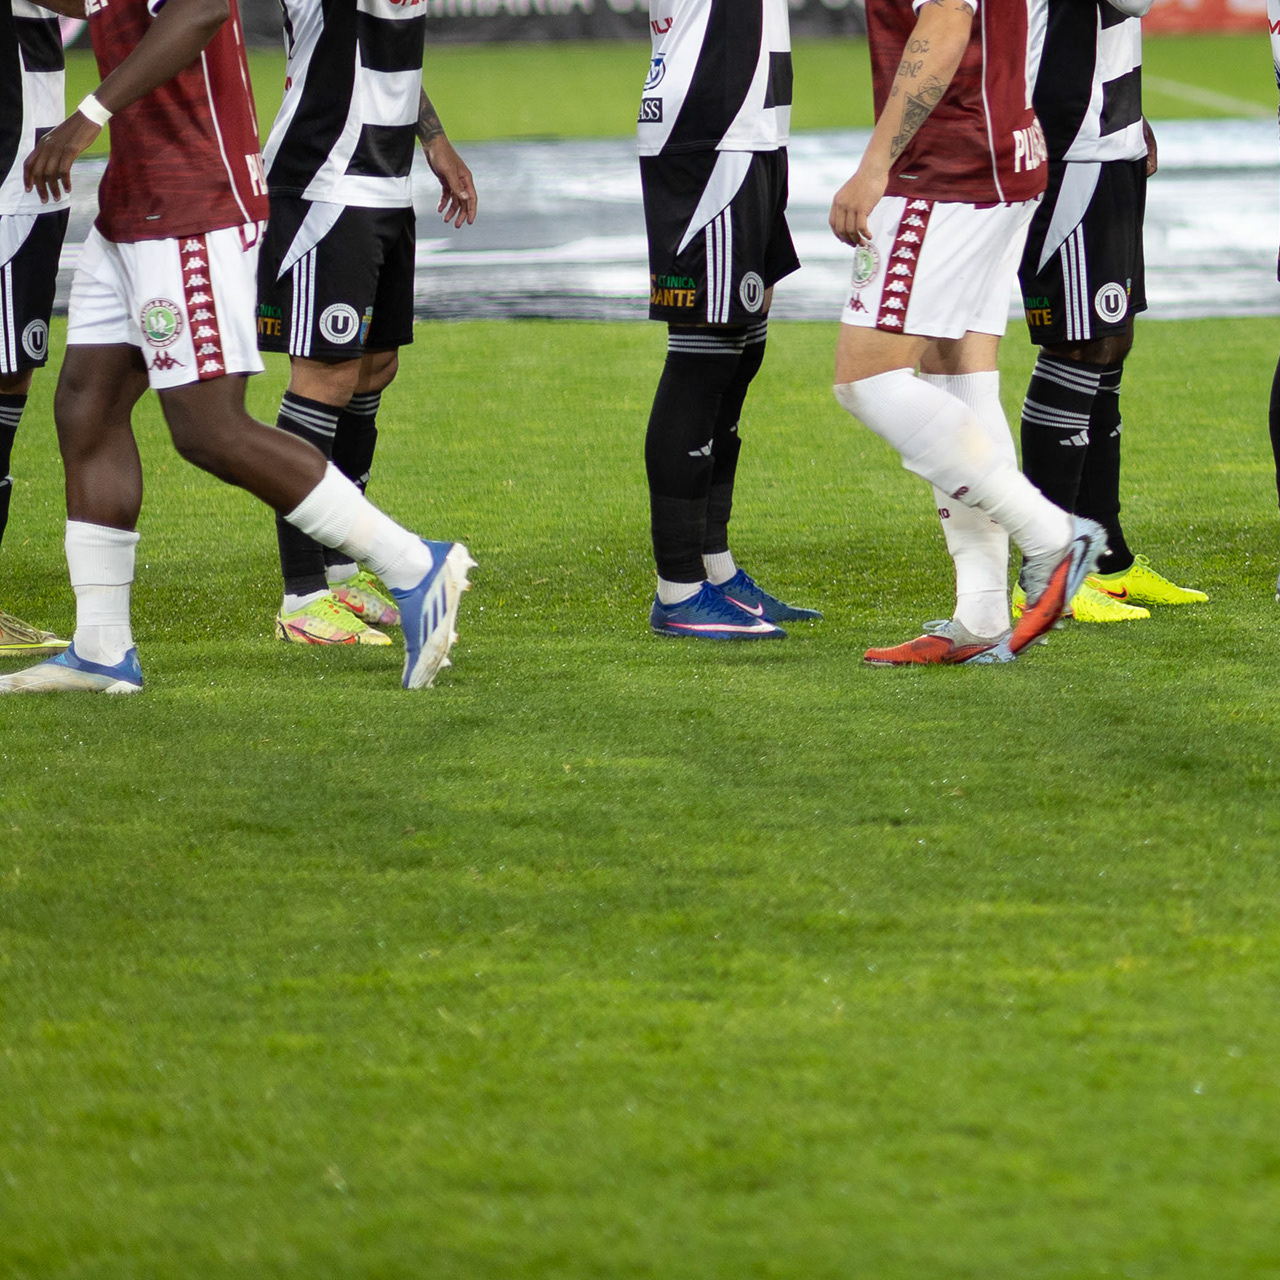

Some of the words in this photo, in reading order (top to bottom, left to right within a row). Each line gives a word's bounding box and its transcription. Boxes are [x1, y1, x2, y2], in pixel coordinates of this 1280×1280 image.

[658, 275, 696, 288] CLINICA
[1104, 293, 1119, 314] U
[331, 314, 350, 335] U
[31, 330, 44, 351] U
